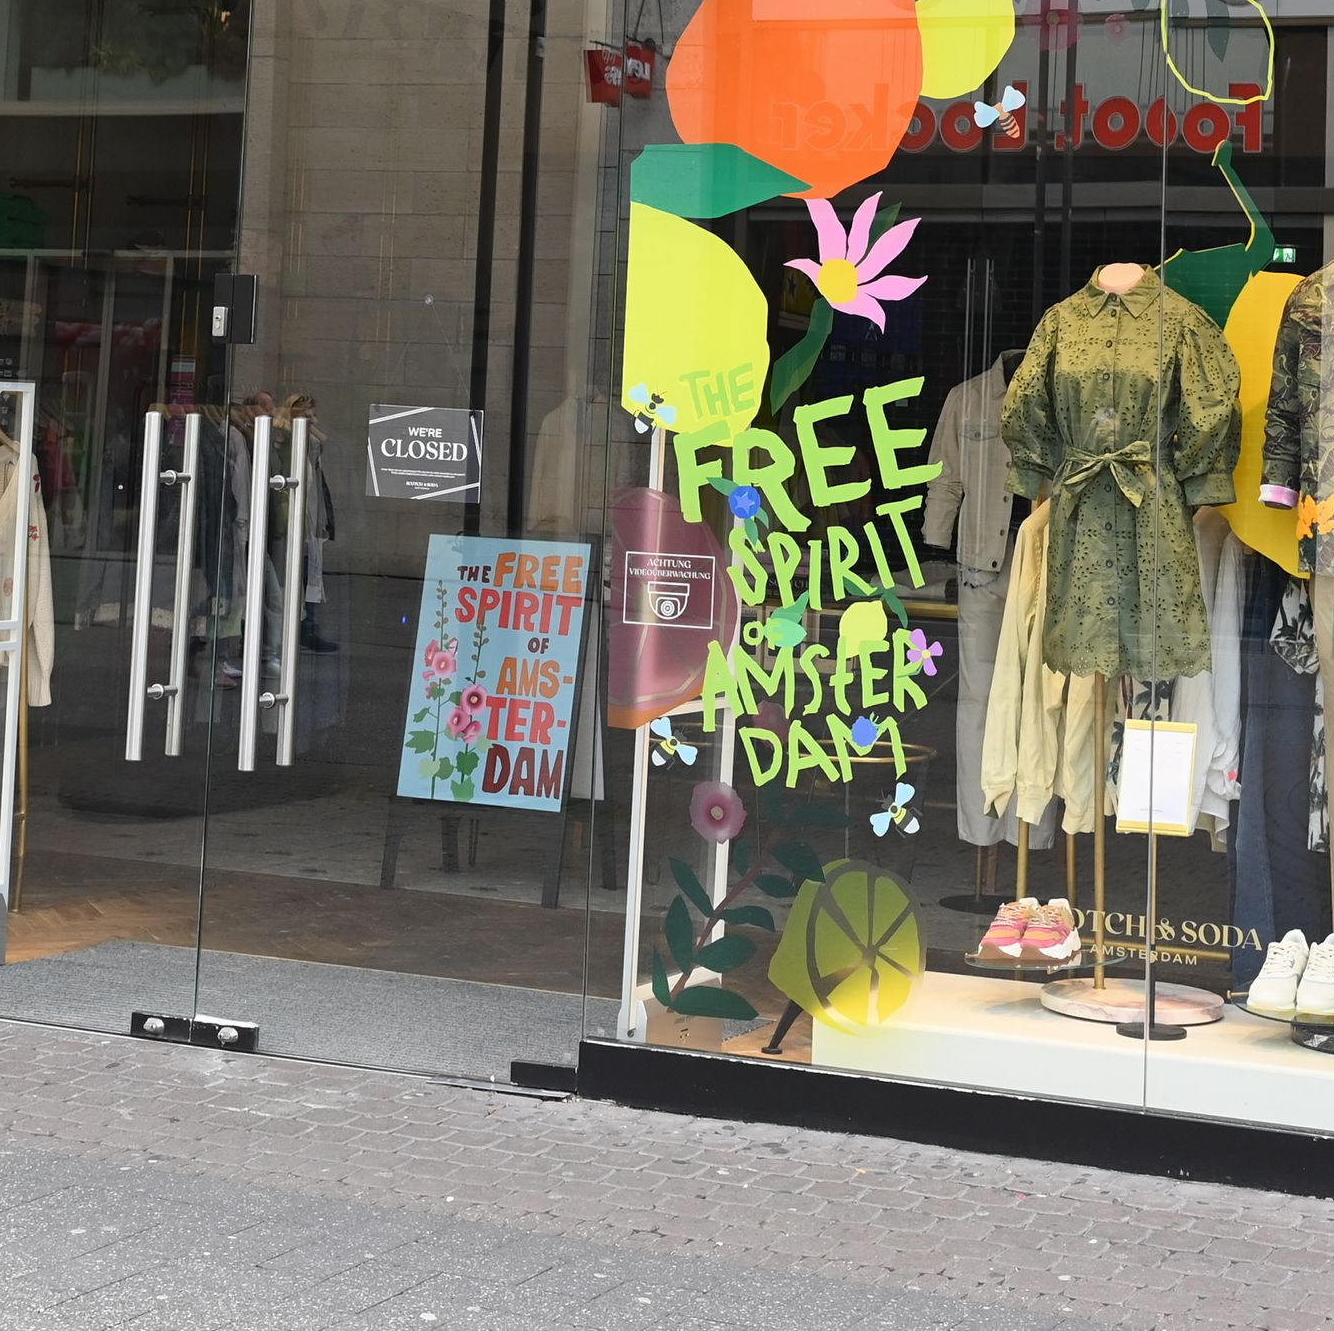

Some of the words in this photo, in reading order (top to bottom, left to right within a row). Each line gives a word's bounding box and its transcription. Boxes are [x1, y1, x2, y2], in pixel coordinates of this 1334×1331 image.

[679, 363, 756, 421] THE
[381, 438, 468, 462] CLOSED
[408, 426, 443, 438] WE'RE
[673, 376, 944, 533] FREE
[457, 565, 491, 584] THE
[492, 551, 583, 594] FREE
[647, 558, 691, 569] ACHTUNG
[727, 495, 926, 610] SPIRIT
[455, 586, 583, 637] SPIRIT
[528, 637, 549, 655] OF
[496, 656, 573, 699] AMS-
[702, 629, 929, 732] AMSTER
[485, 696, 566, 746] TER-
[481, 744, 564, 800] DAM
[739, 714, 907, 788] DAM
[1073, 908, 1146, 939] OTCH
[1153, 917, 1176, 942] &
[1181, 920, 1263, 951] SODA
[1090, 944, 1198, 966] AMSTERDAM
